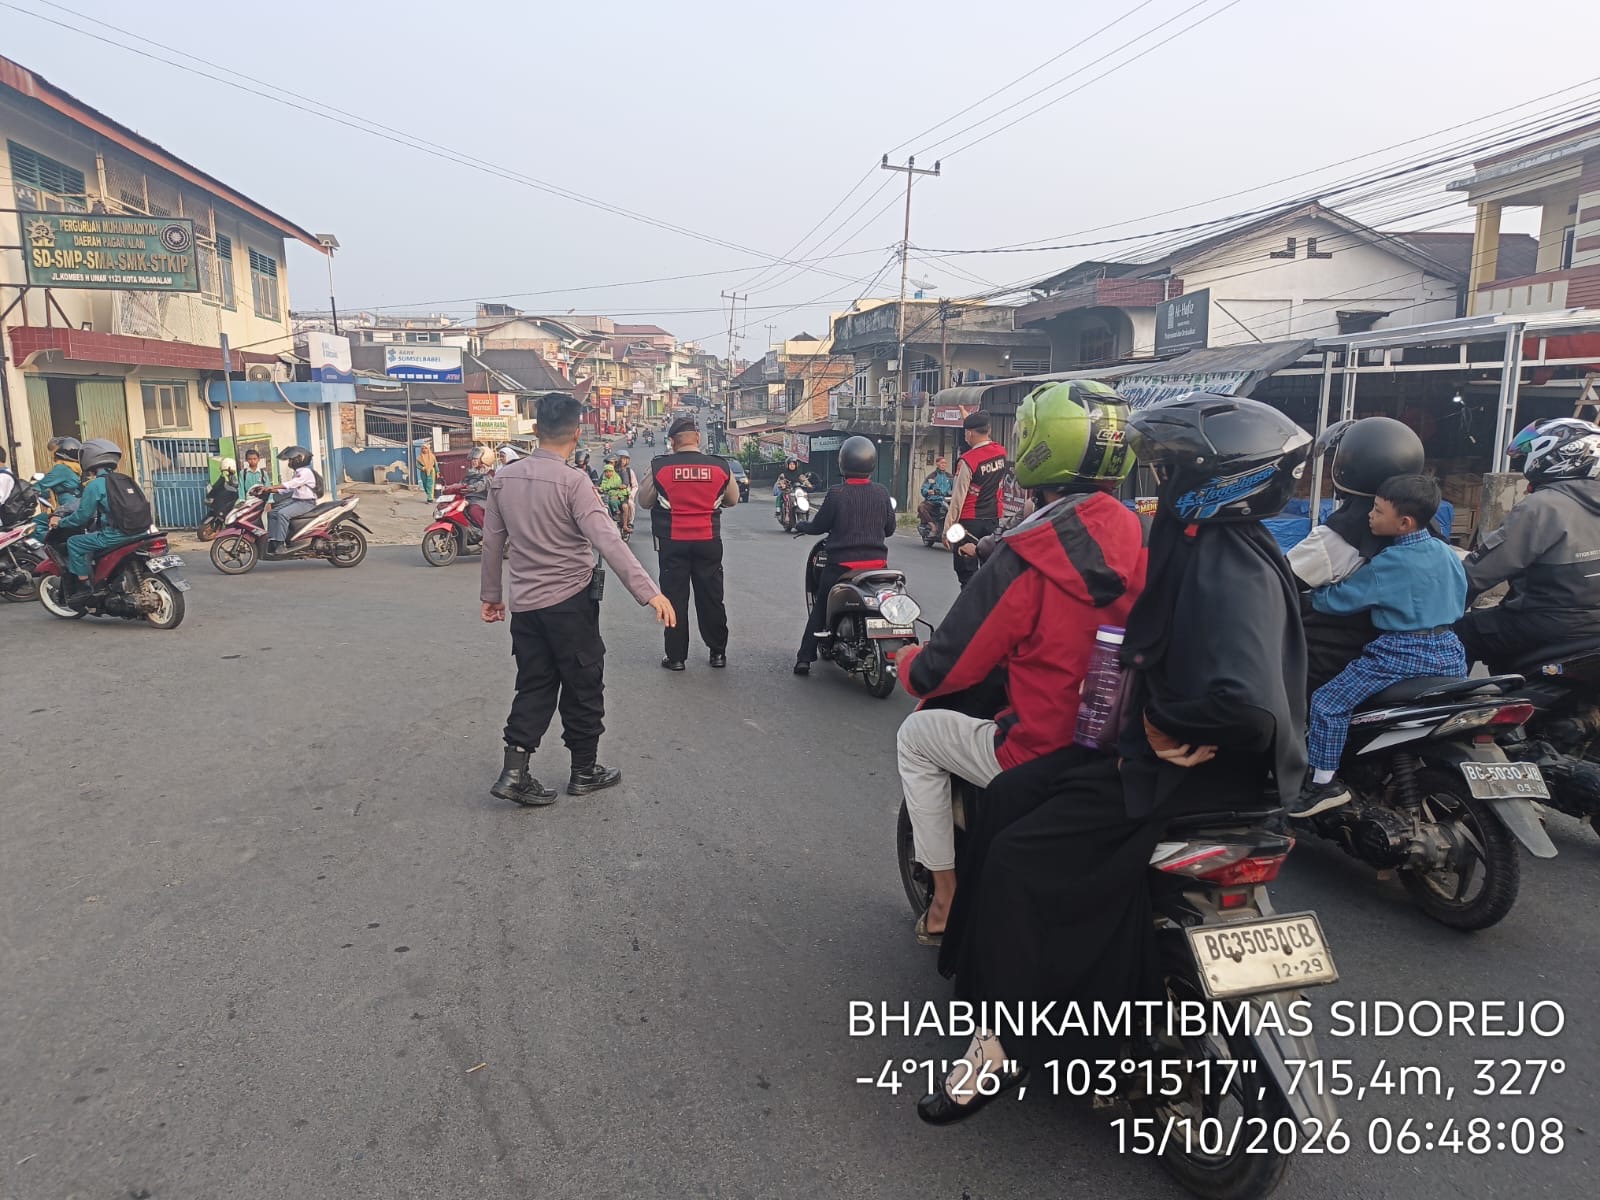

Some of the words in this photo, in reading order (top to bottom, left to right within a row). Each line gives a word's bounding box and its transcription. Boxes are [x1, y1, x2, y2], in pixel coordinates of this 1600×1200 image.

[102, 222, 158, 236] MUHAMMADIYAH
[74, 235, 102, 247] DAERAH
[1098, 430, 1125, 441] GM
[981, 458, 1005, 476] POLISI
[675, 468, 711, 480] POLISI
[1466, 766, 1485, 780] BG
[1487, 766, 1522, 780] 5030
